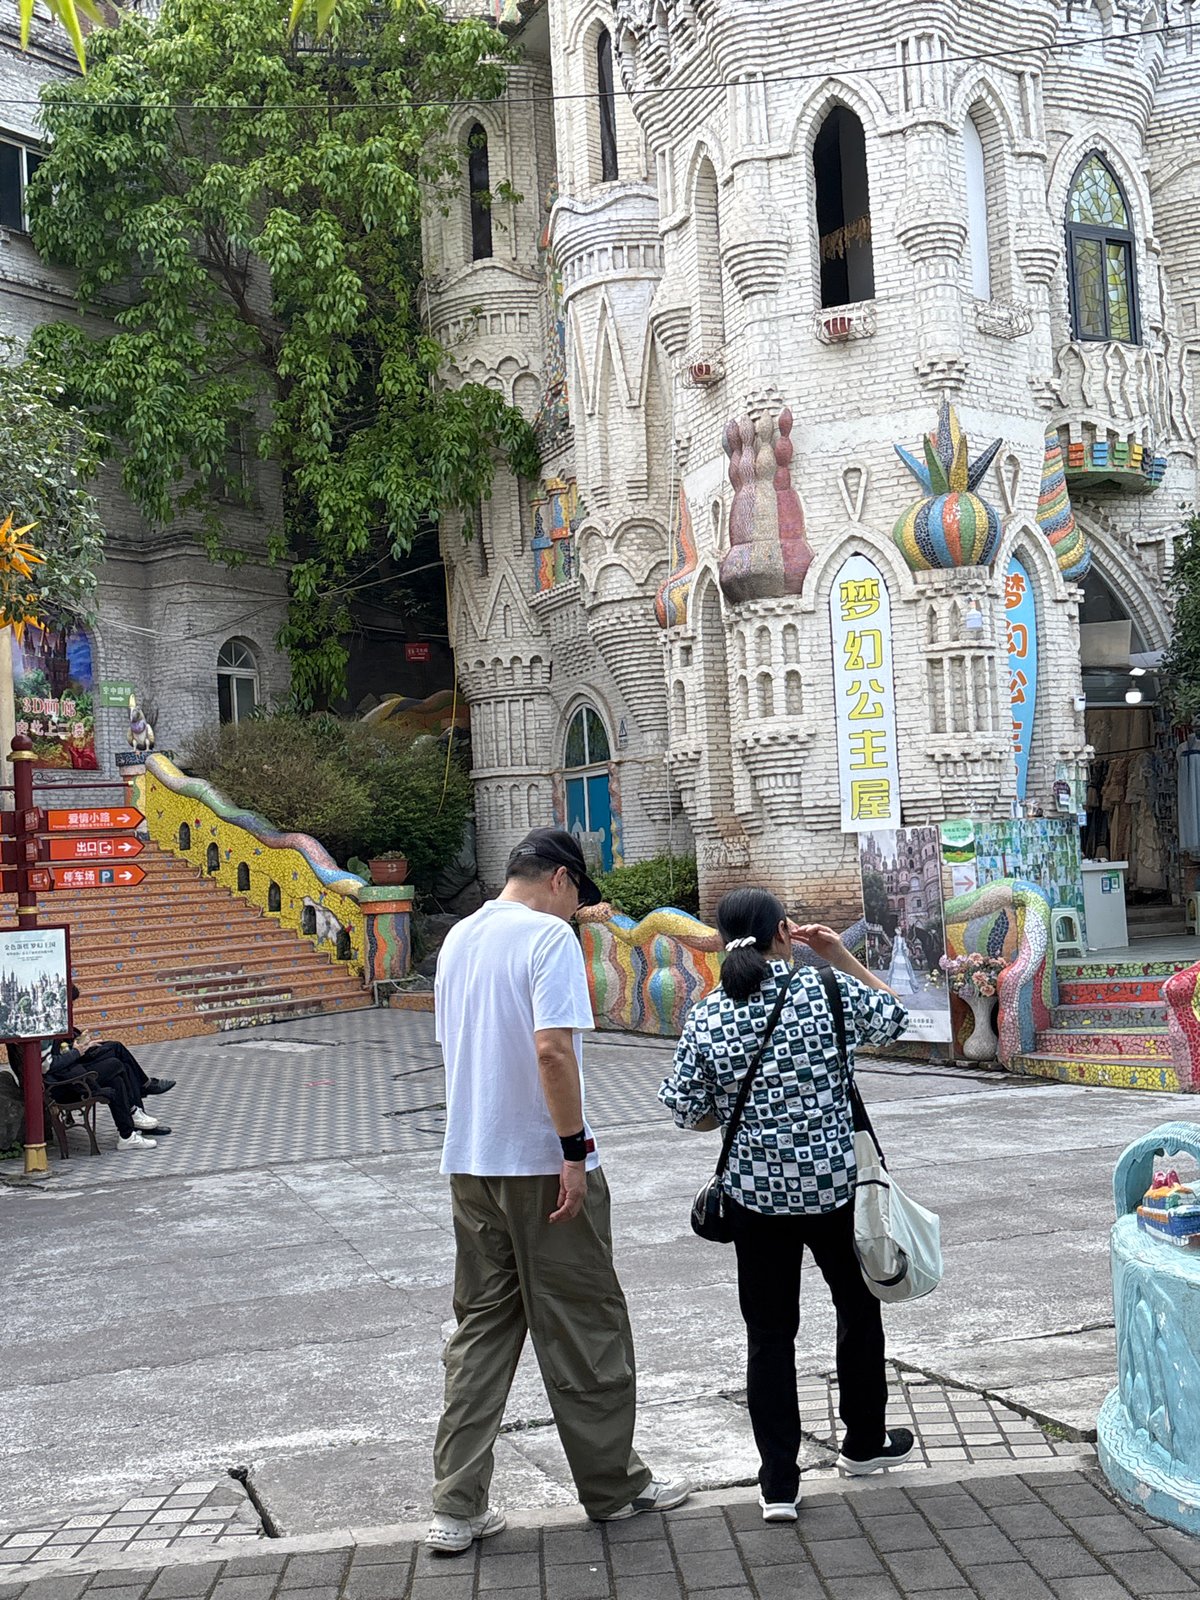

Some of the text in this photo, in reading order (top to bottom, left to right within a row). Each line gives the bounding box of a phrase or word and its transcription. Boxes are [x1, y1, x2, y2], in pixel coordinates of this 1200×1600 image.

[1005, 573, 1028, 775] 梦幻公
[839, 577, 892, 821] 梦幻公主屋
[68, 812, 111, 824] 爱情小路
[76, 841, 97, 853] 出口
[63, 870, 95, 883] 停车场
[102, 871, 111, 883] P
